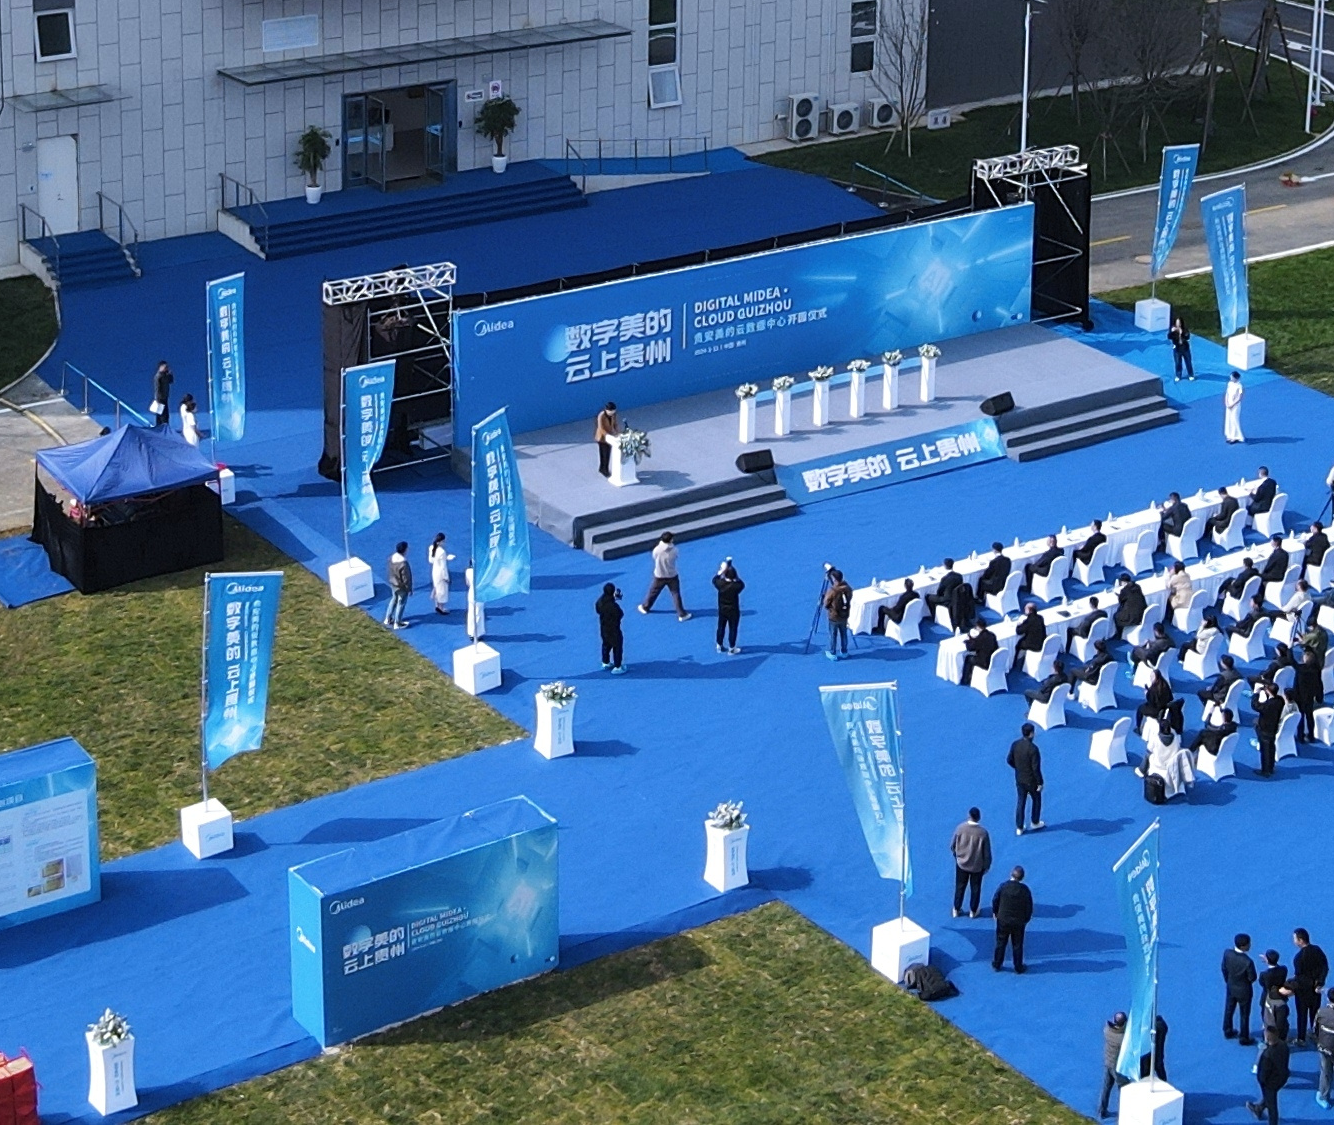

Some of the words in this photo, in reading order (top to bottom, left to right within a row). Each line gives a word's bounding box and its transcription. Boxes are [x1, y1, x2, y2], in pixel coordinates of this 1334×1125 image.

[694, 294, 740, 314] DIGITAL
[743, 286, 781, 305] MIDEA
[474, 319, 514, 336] Midea
[564, 308, 672, 352] 数字美的
[694, 310, 735, 328] CLOUD
[564, 337, 671, 384] 云上贵州
[801, 454, 892, 493] 数字美的
[895, 431, 982, 472] 云上贵州
[226, 582, 264, 595] Midea
[225, 601, 242, 661] 数字美的
[329, 896, 365, 915] Midea
[342, 926, 405, 960] 数字美的
[343, 941, 405, 976] 云上贵州
